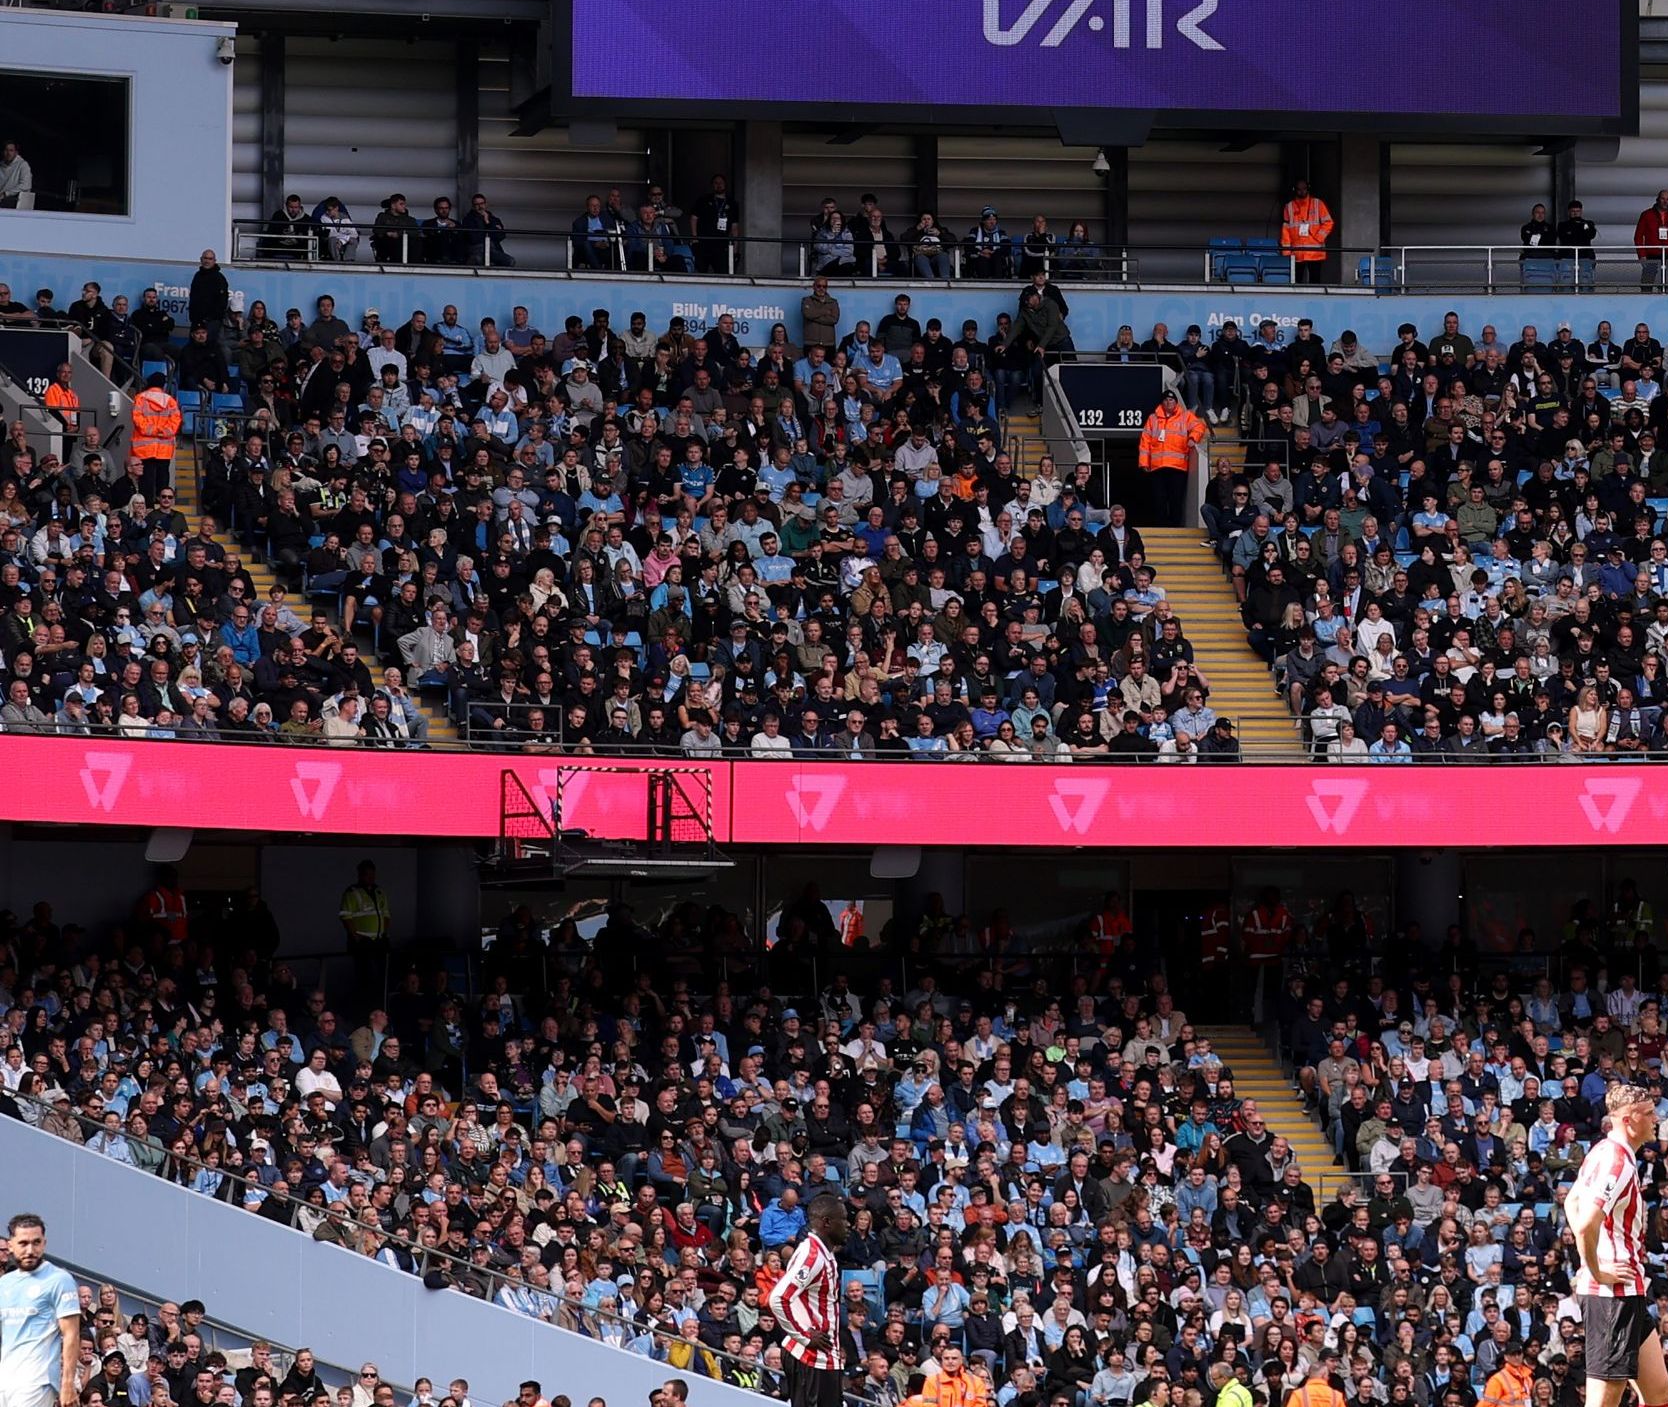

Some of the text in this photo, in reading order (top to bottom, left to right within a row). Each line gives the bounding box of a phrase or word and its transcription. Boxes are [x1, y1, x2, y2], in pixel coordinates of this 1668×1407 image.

[672, 302, 785, 320] Billy Meredith
[26, 376, 50, 395] 132
[1079, 409, 1143, 426] 132 133
